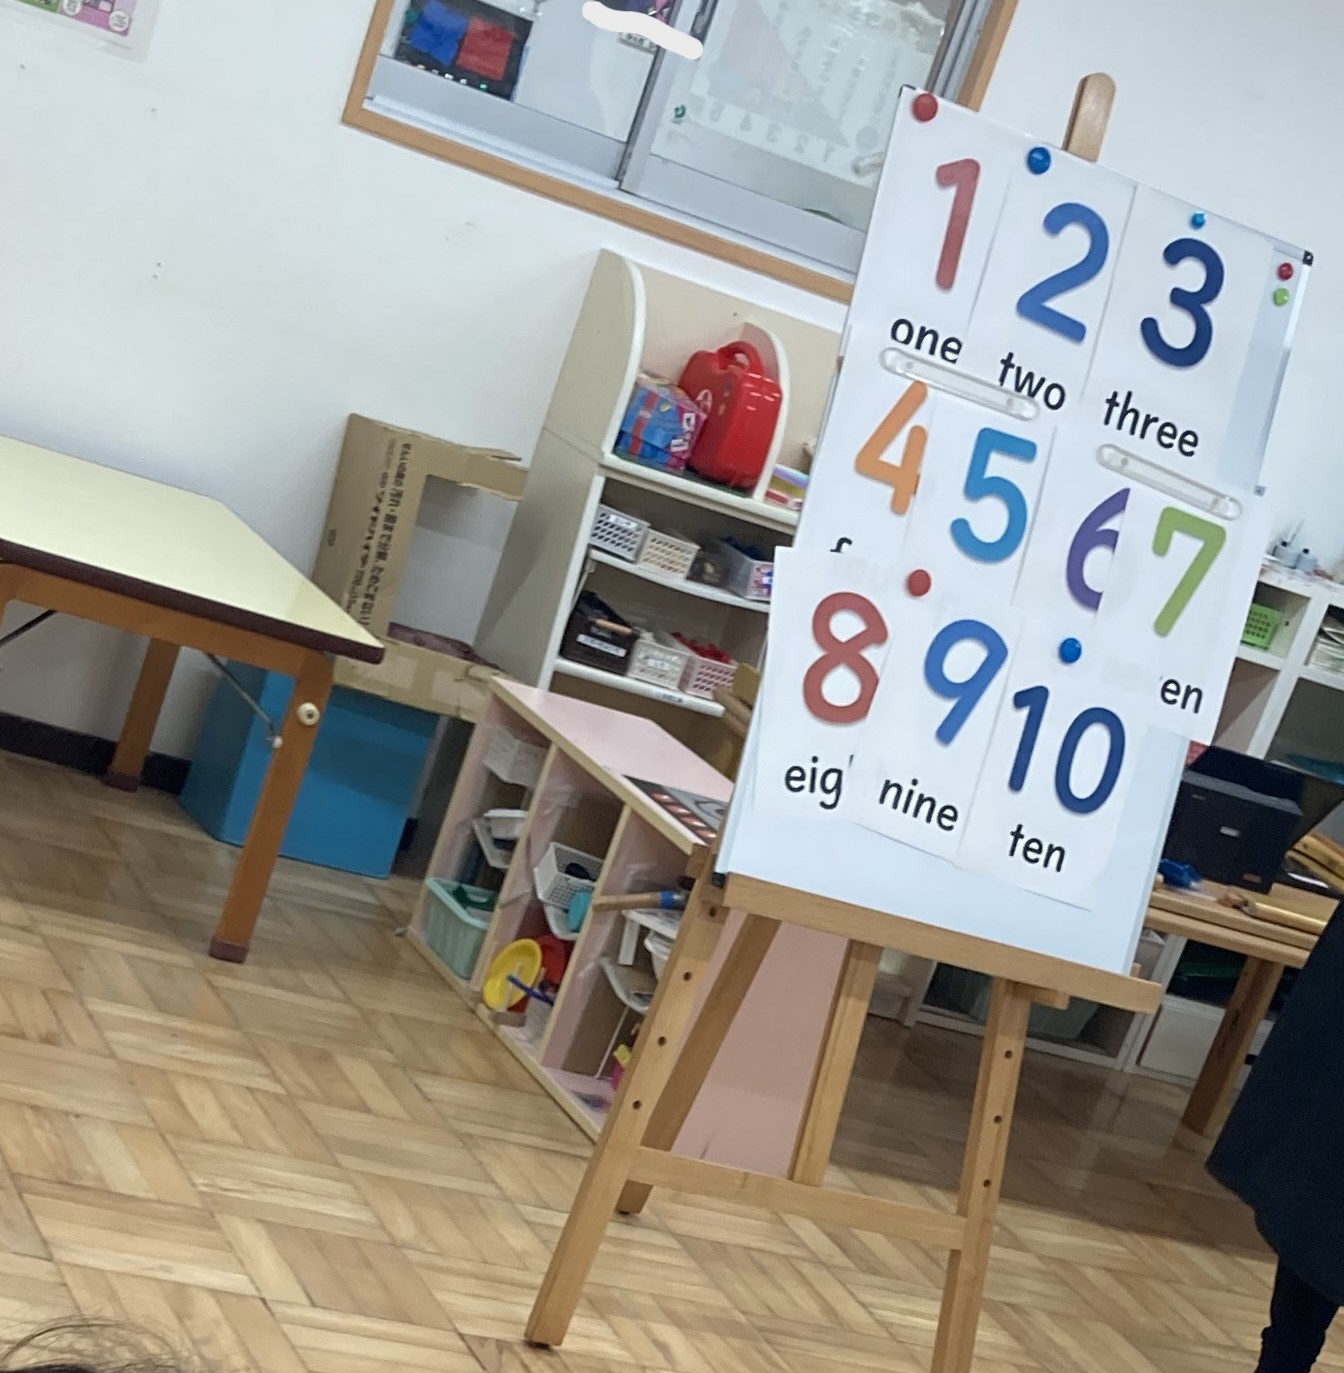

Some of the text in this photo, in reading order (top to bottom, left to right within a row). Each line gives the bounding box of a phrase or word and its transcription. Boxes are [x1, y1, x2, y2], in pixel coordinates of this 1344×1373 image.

[937, 158, 981, 290] 1
[1015, 201, 1111, 344] 2
[889, 317, 963, 364] one
[1139, 236, 1226, 369] 3
[998, 351, 1067, 411] two
[1103, 389, 1200, 457] three
[854, 380, 928, 515] 4
[949, 426, 1038, 564] 5
[1066, 487, 1131, 612] 6
[1151, 505, 1227, 637] 7
[802, 591, 889, 724] 8
[922, 618, 1009, 746] 9
[1158, 676, 1204, 714] en
[783, 754, 856, 811] eig
[879, 778, 959, 831] nine
[1007, 684, 1127, 815] 10
[1008, 822, 1067, 873] ten
